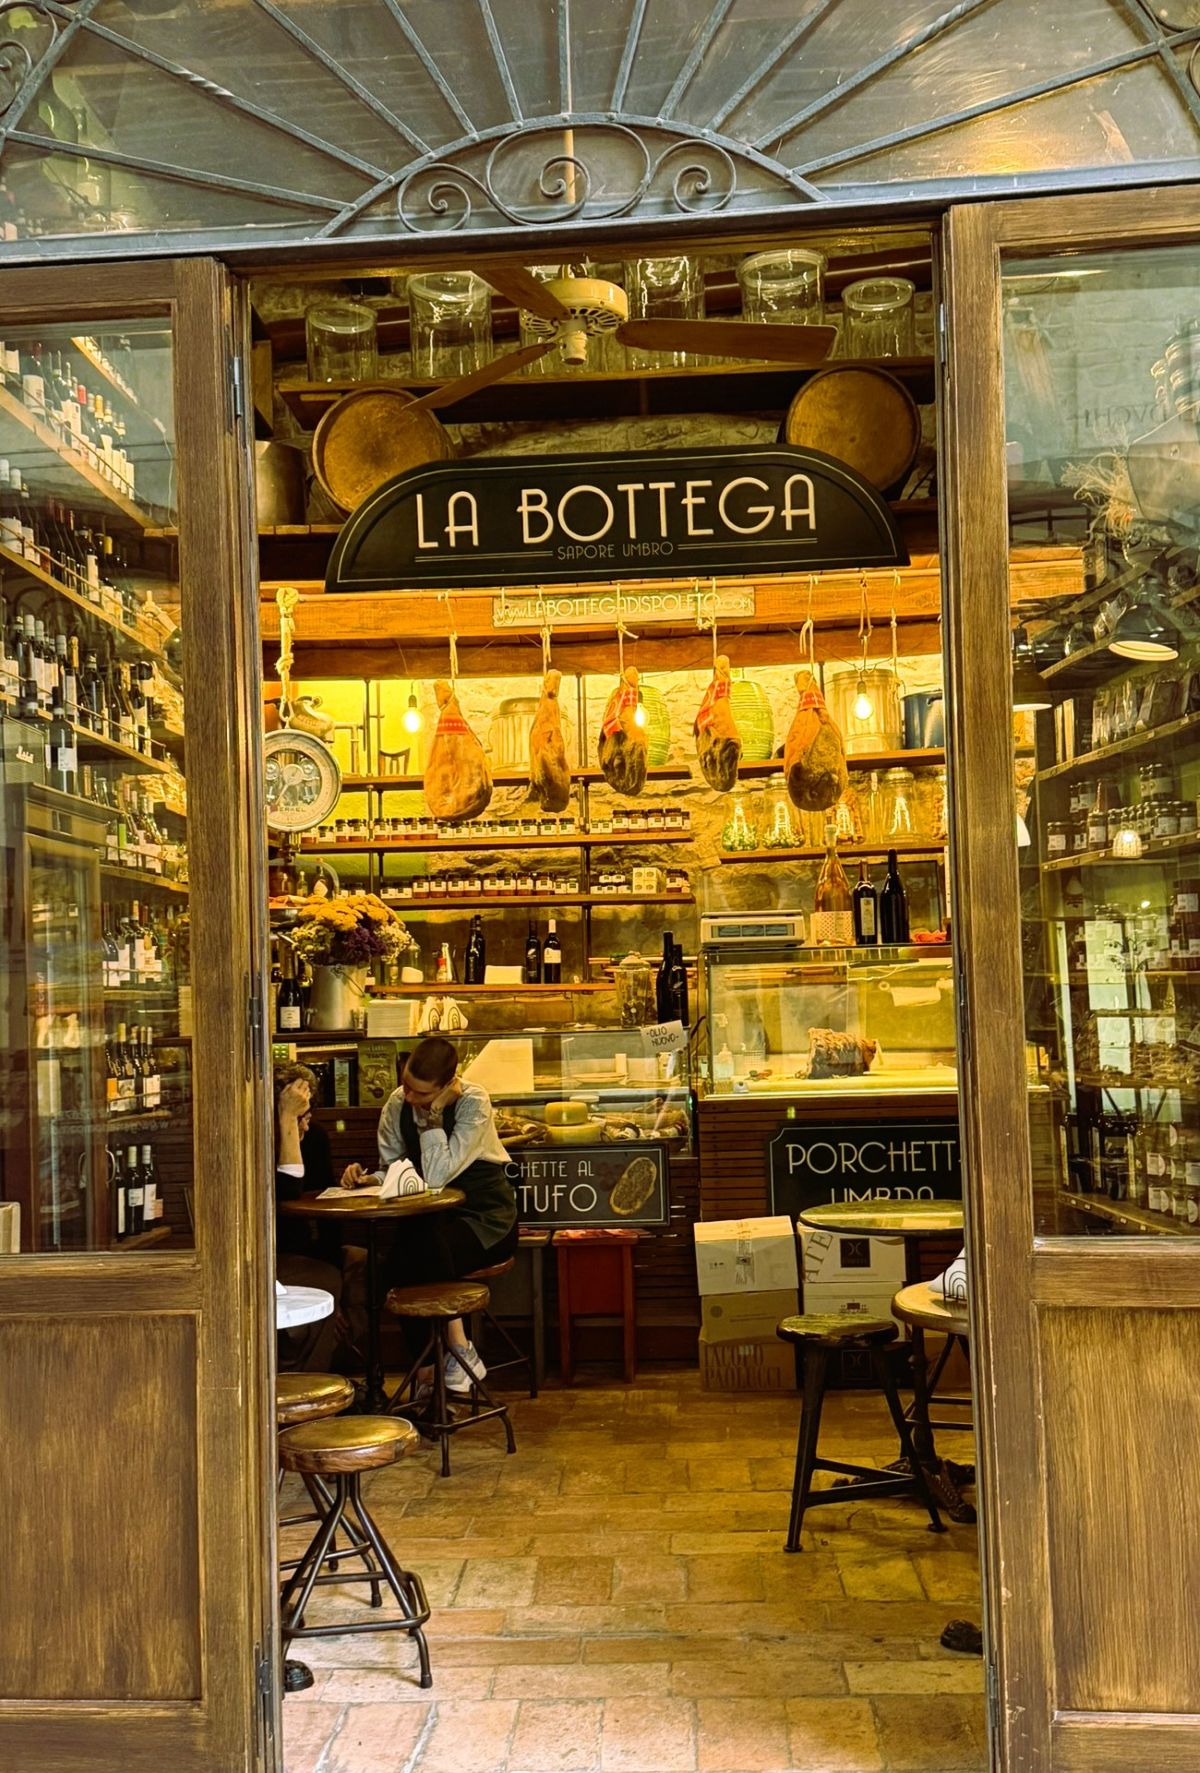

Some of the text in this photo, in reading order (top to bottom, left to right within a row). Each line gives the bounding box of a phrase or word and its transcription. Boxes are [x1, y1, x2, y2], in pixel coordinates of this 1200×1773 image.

[416, 474, 817, 548] LA BOTTEGA
[558, 541, 674, 560] SAPORE UMBRO
[578, 1160, 595, 1177] AL
[785, 1140, 962, 1175] PORCHETT
[513, 1183, 598, 1213] TUFO
